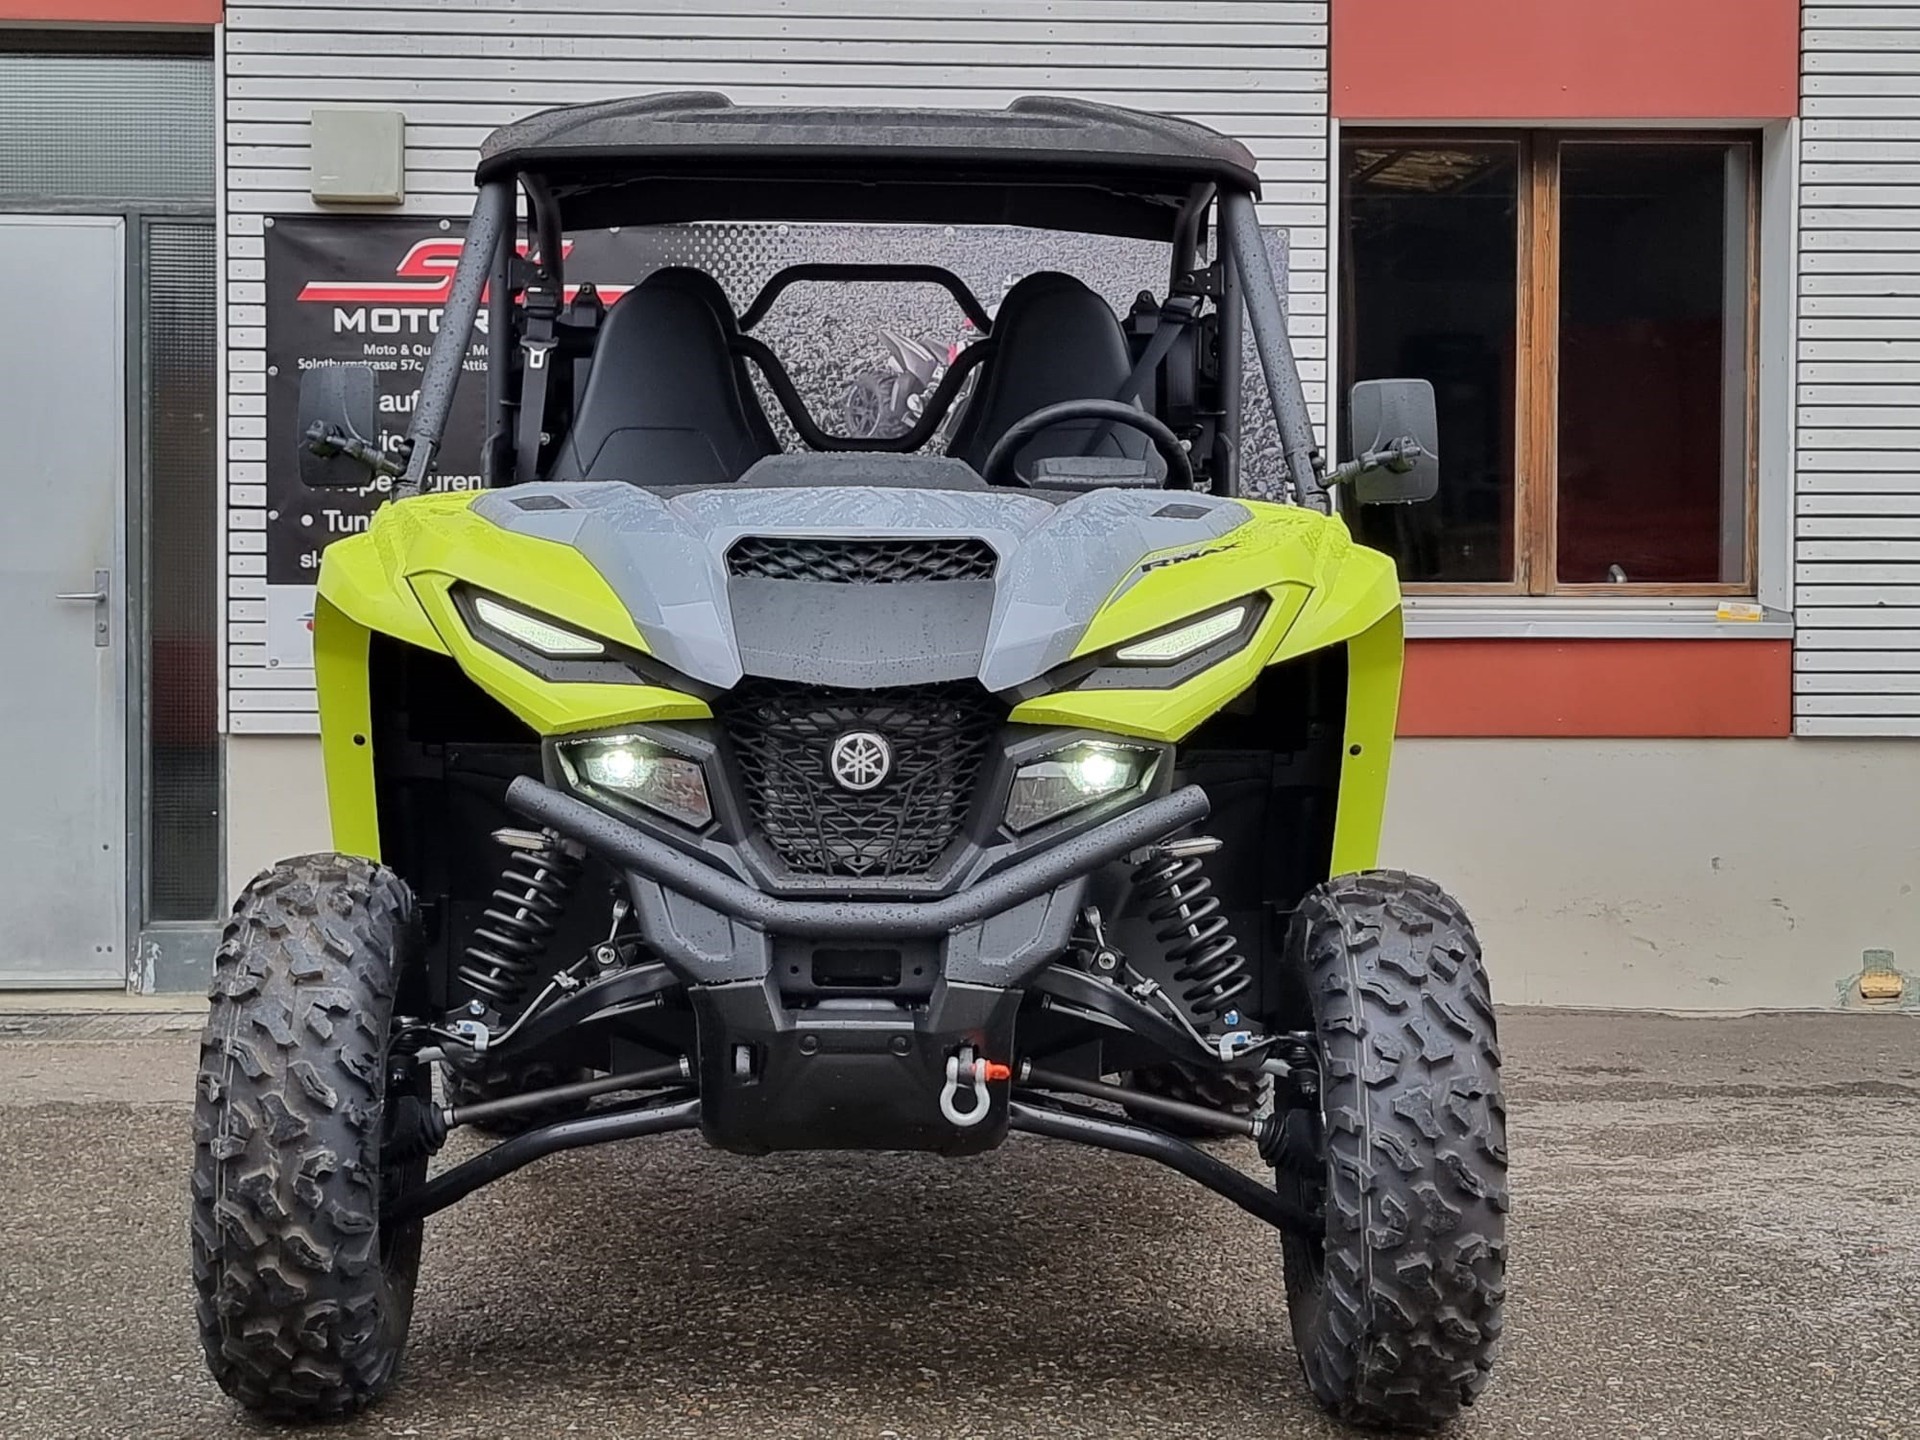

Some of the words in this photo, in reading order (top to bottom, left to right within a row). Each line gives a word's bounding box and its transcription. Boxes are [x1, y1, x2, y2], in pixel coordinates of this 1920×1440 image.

[363, 344, 397, 356] Moto
[400, 344, 410, 356] &
[412, 344, 431, 358] Qu
[400, 359, 424, 372] 57c,
[462, 359, 488, 371] Attis
[322, 509, 376, 532] Tuni
